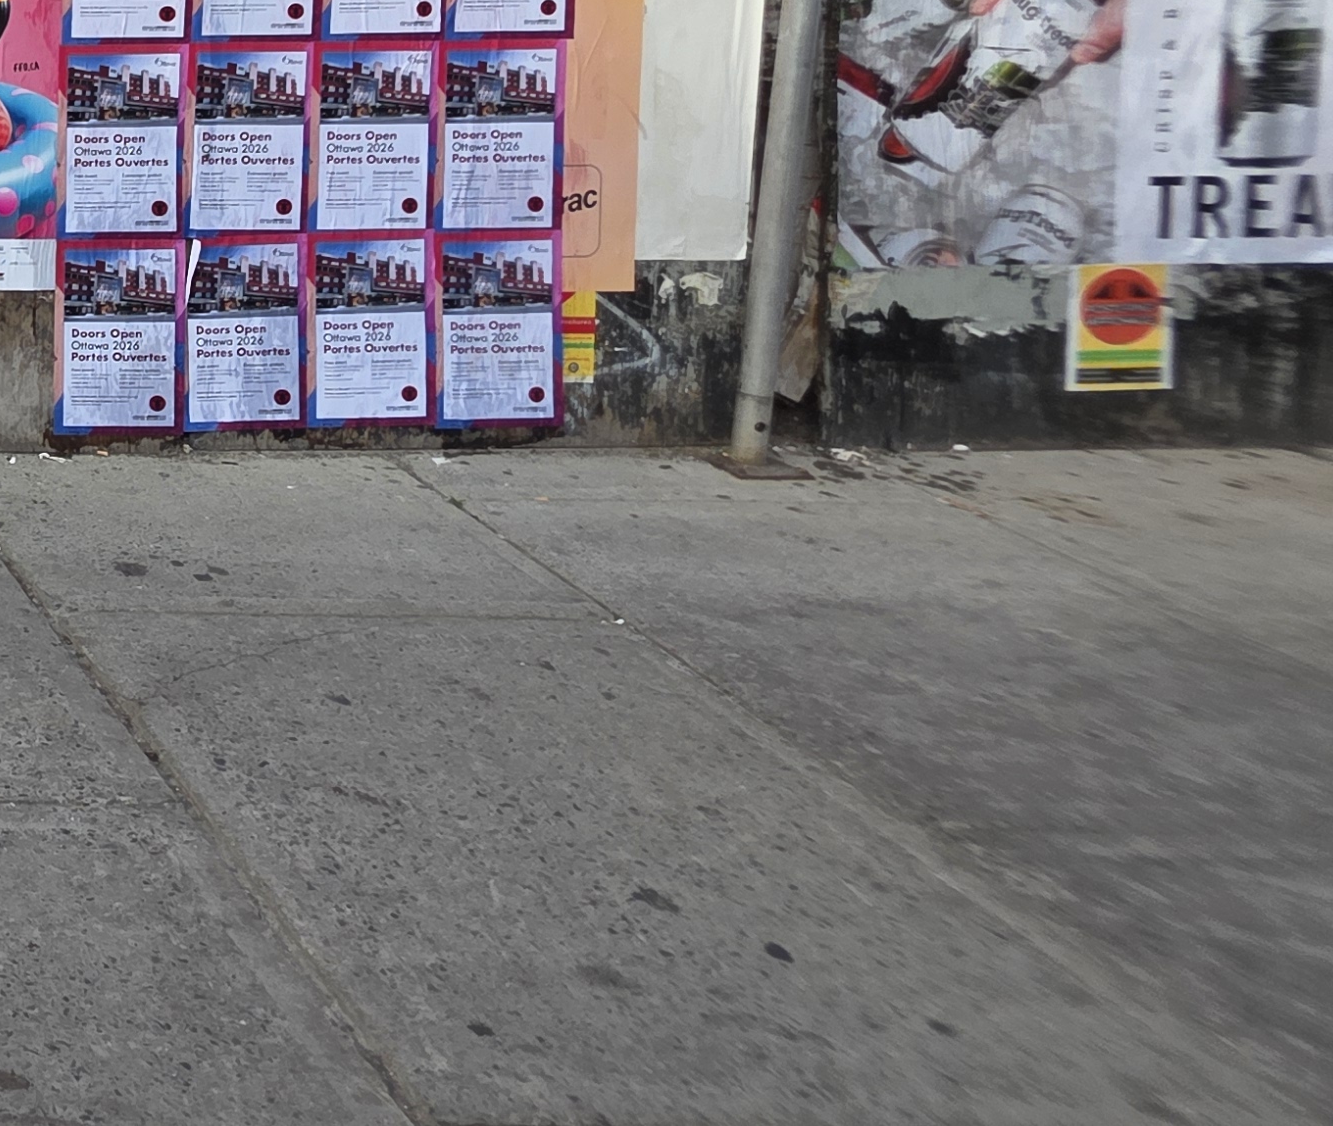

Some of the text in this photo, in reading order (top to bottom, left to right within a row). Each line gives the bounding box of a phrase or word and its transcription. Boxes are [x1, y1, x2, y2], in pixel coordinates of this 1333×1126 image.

[450, 320, 521, 333] Doors Open
[450, 332, 519, 343] Ottawa 2026
[450, 344, 545, 355] Portes Ouvertes
